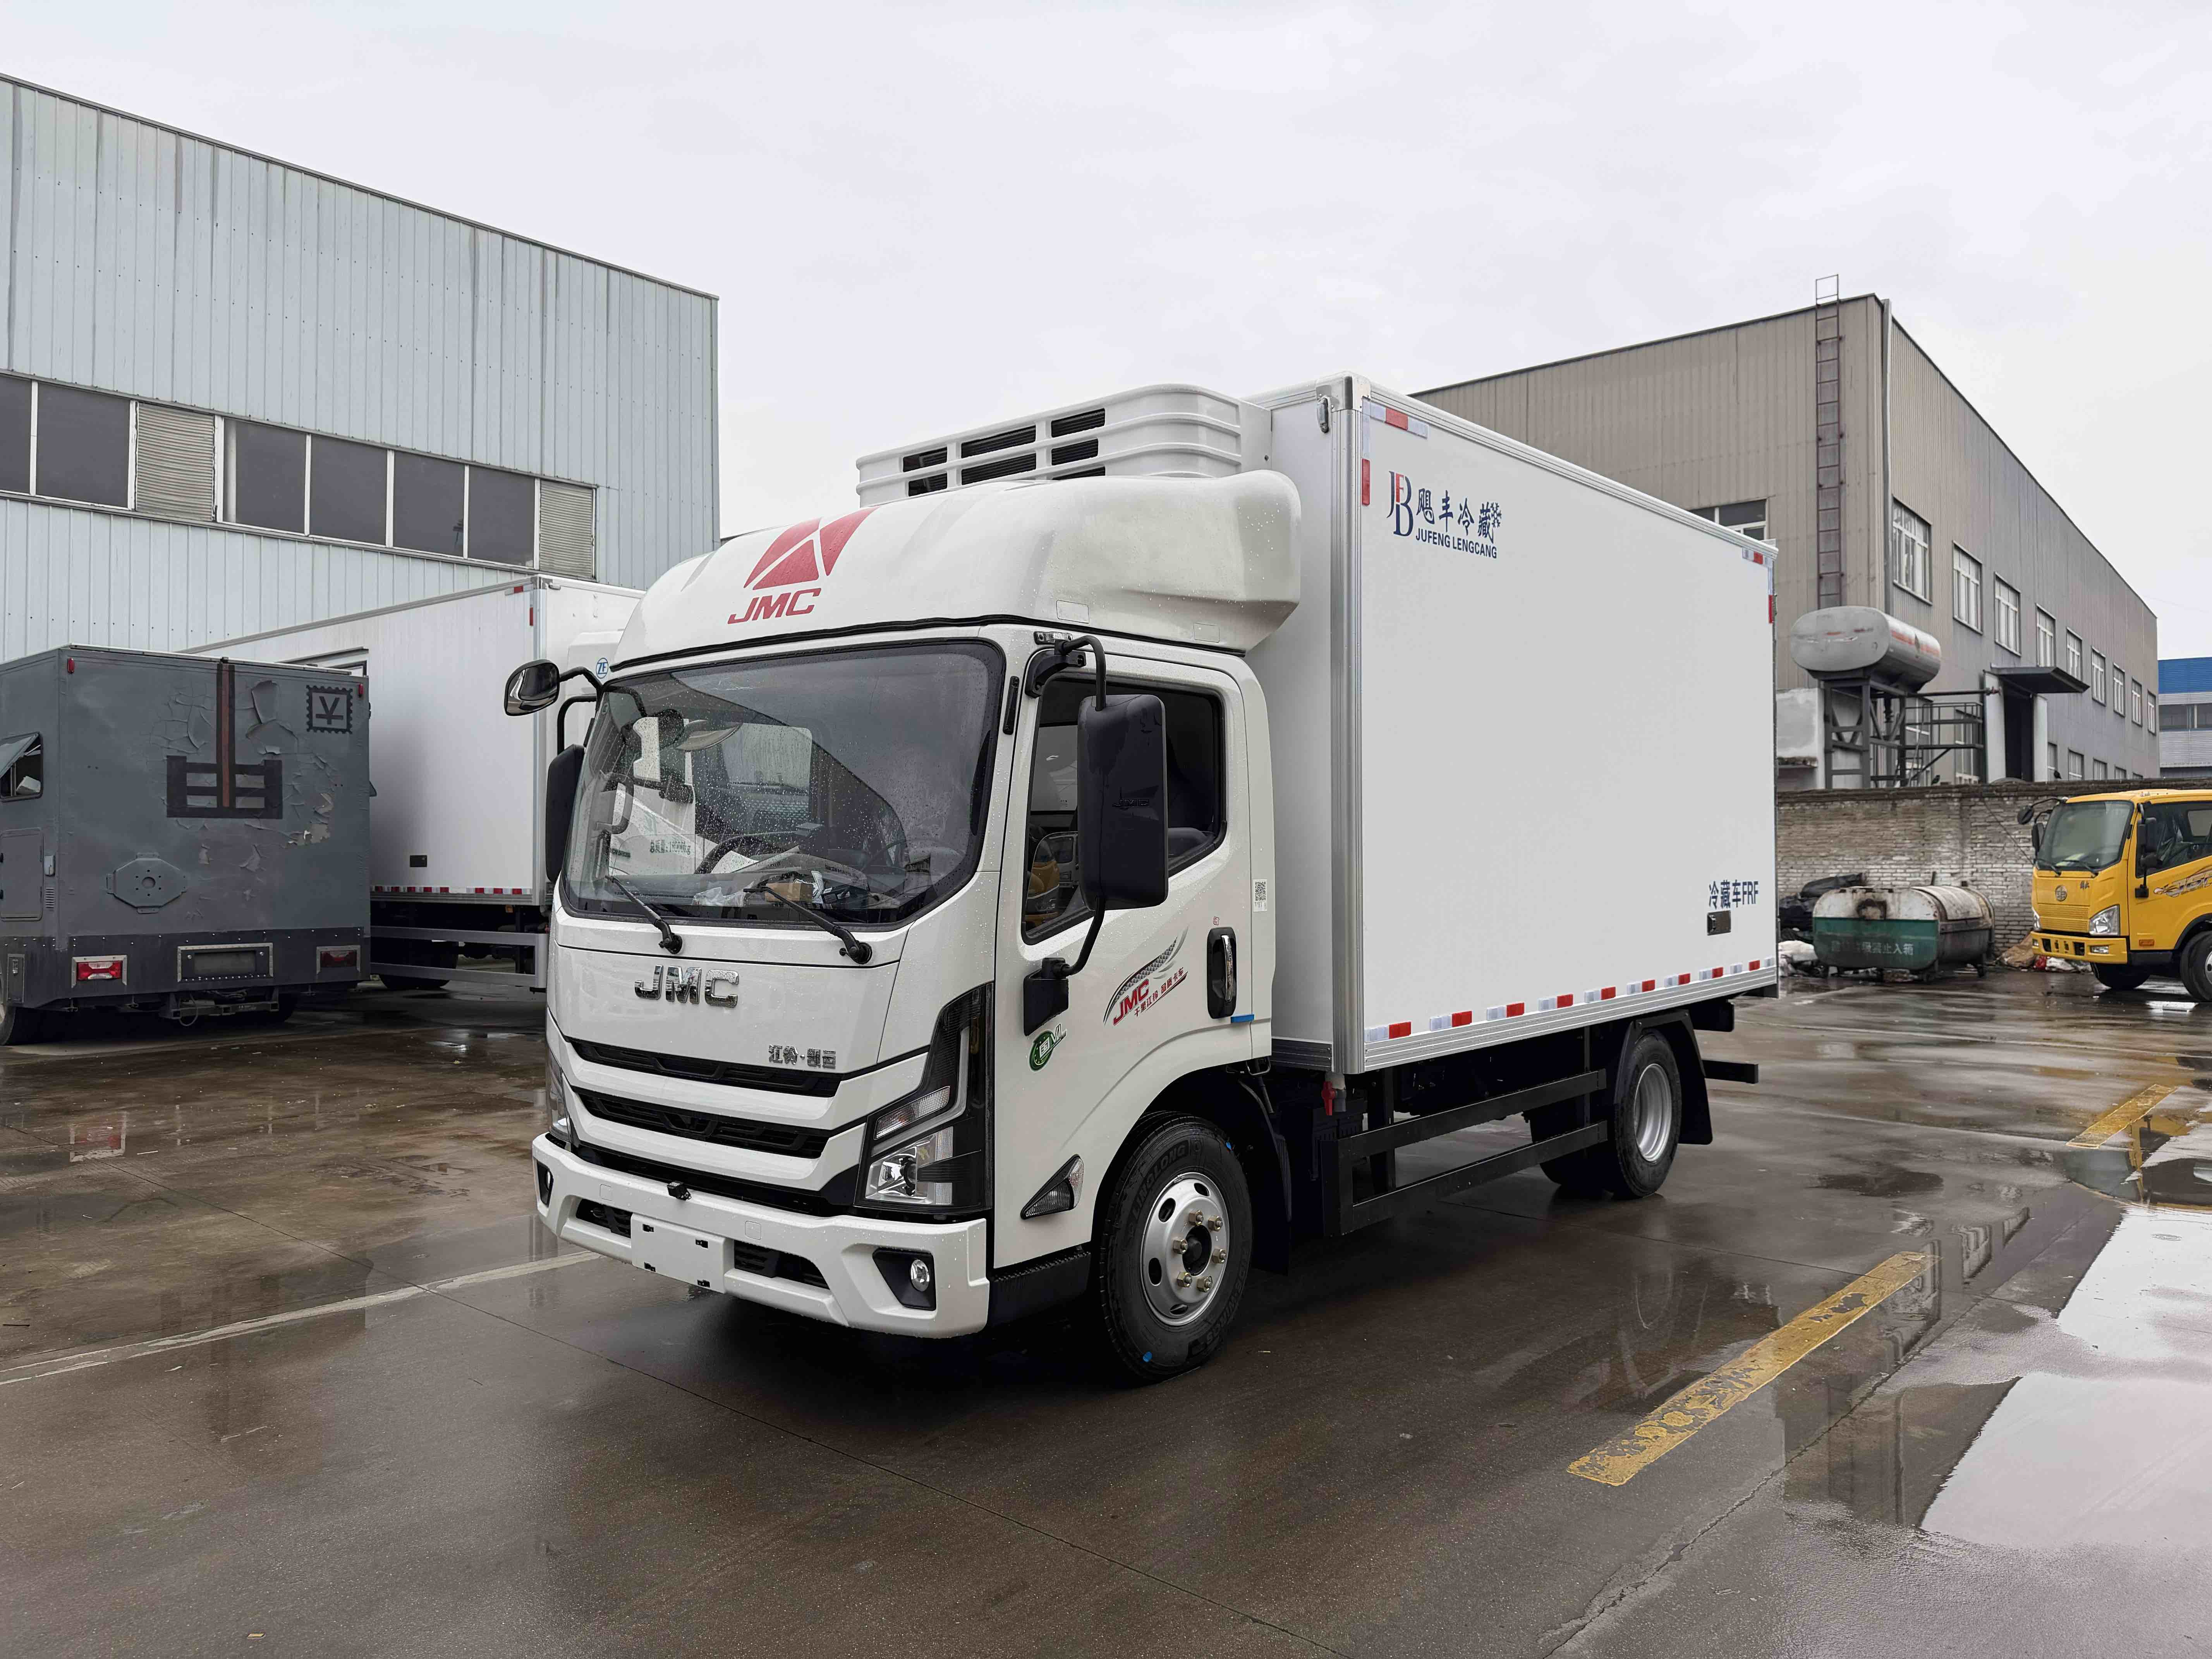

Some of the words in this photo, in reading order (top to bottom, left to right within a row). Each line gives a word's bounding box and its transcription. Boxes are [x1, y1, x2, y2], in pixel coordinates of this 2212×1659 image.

[1416, 528, 1450, 548] JUFENG
[1452, 536, 1497, 558] LENGCANG
[727, 587, 821, 624] JMC
[634, 964, 739, 1008] JMC
[1113, 978, 1149, 1025] JMC
